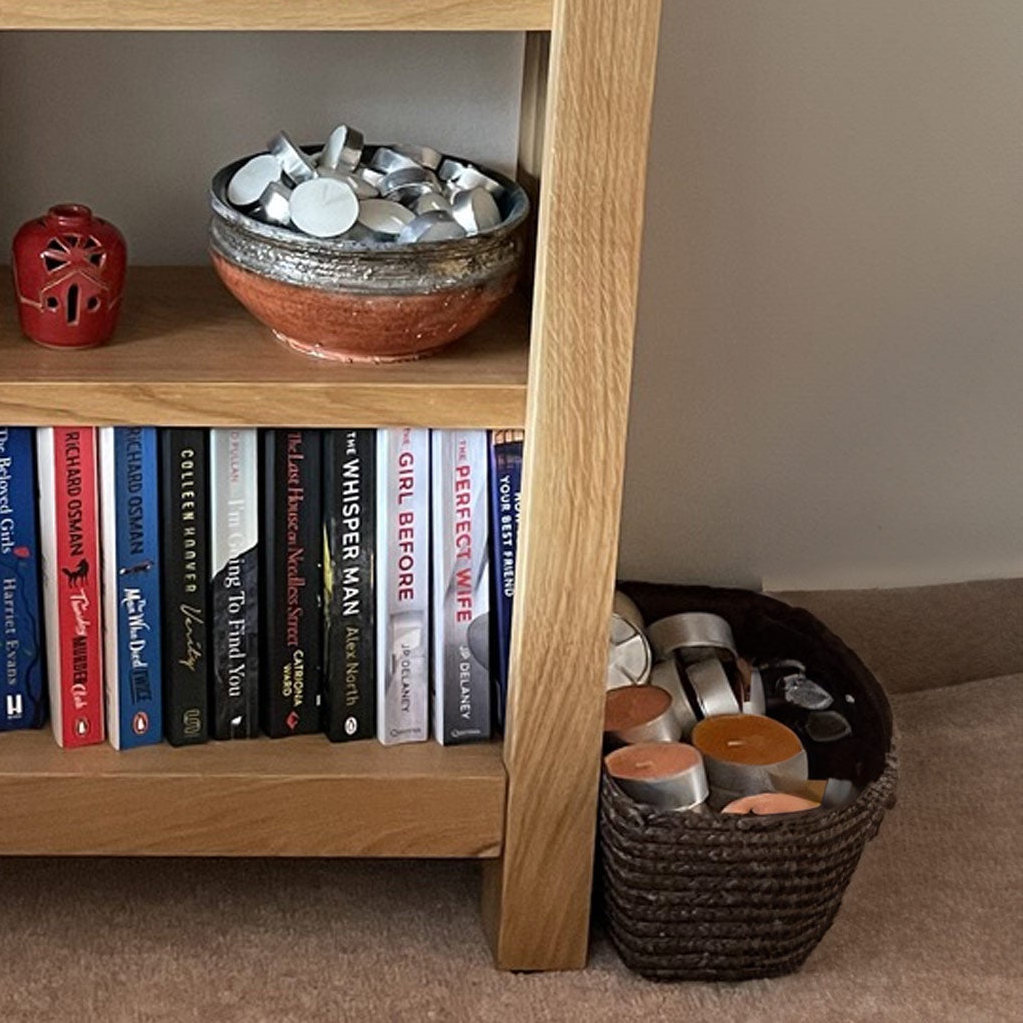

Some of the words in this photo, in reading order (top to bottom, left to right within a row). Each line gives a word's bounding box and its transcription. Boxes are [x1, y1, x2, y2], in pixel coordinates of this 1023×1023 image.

[65, 431, 83, 497] RICHARD
[125, 427, 144, 494] RICHARD
[398, 452, 414, 505] GIRL
[342, 458, 360, 561] WHISPER
[455, 466, 472, 559] PERFECT
[500, 475, 511, 512] YOUR
[0, 518, 15, 555] Girls
[67, 499, 84, 557] OSMAN
[127, 496, 145, 555] OSMAN
[501, 515, 513, 547] BEST
[398, 512, 414, 601] BEFORE
[3, 578, 17, 634] Harriet
[228, 591, 245, 614] To
[342, 567, 360, 616] MAN
[455, 568, 473, 622] WIFE
[5, 639, 20, 685] Evans
[228, 618, 247, 659] Find
[345, 626, 359, 660] Alex
[228, 664, 246, 697] You
[345, 662, 359, 707] North
[459, 663, 470, 720] DELANEY
